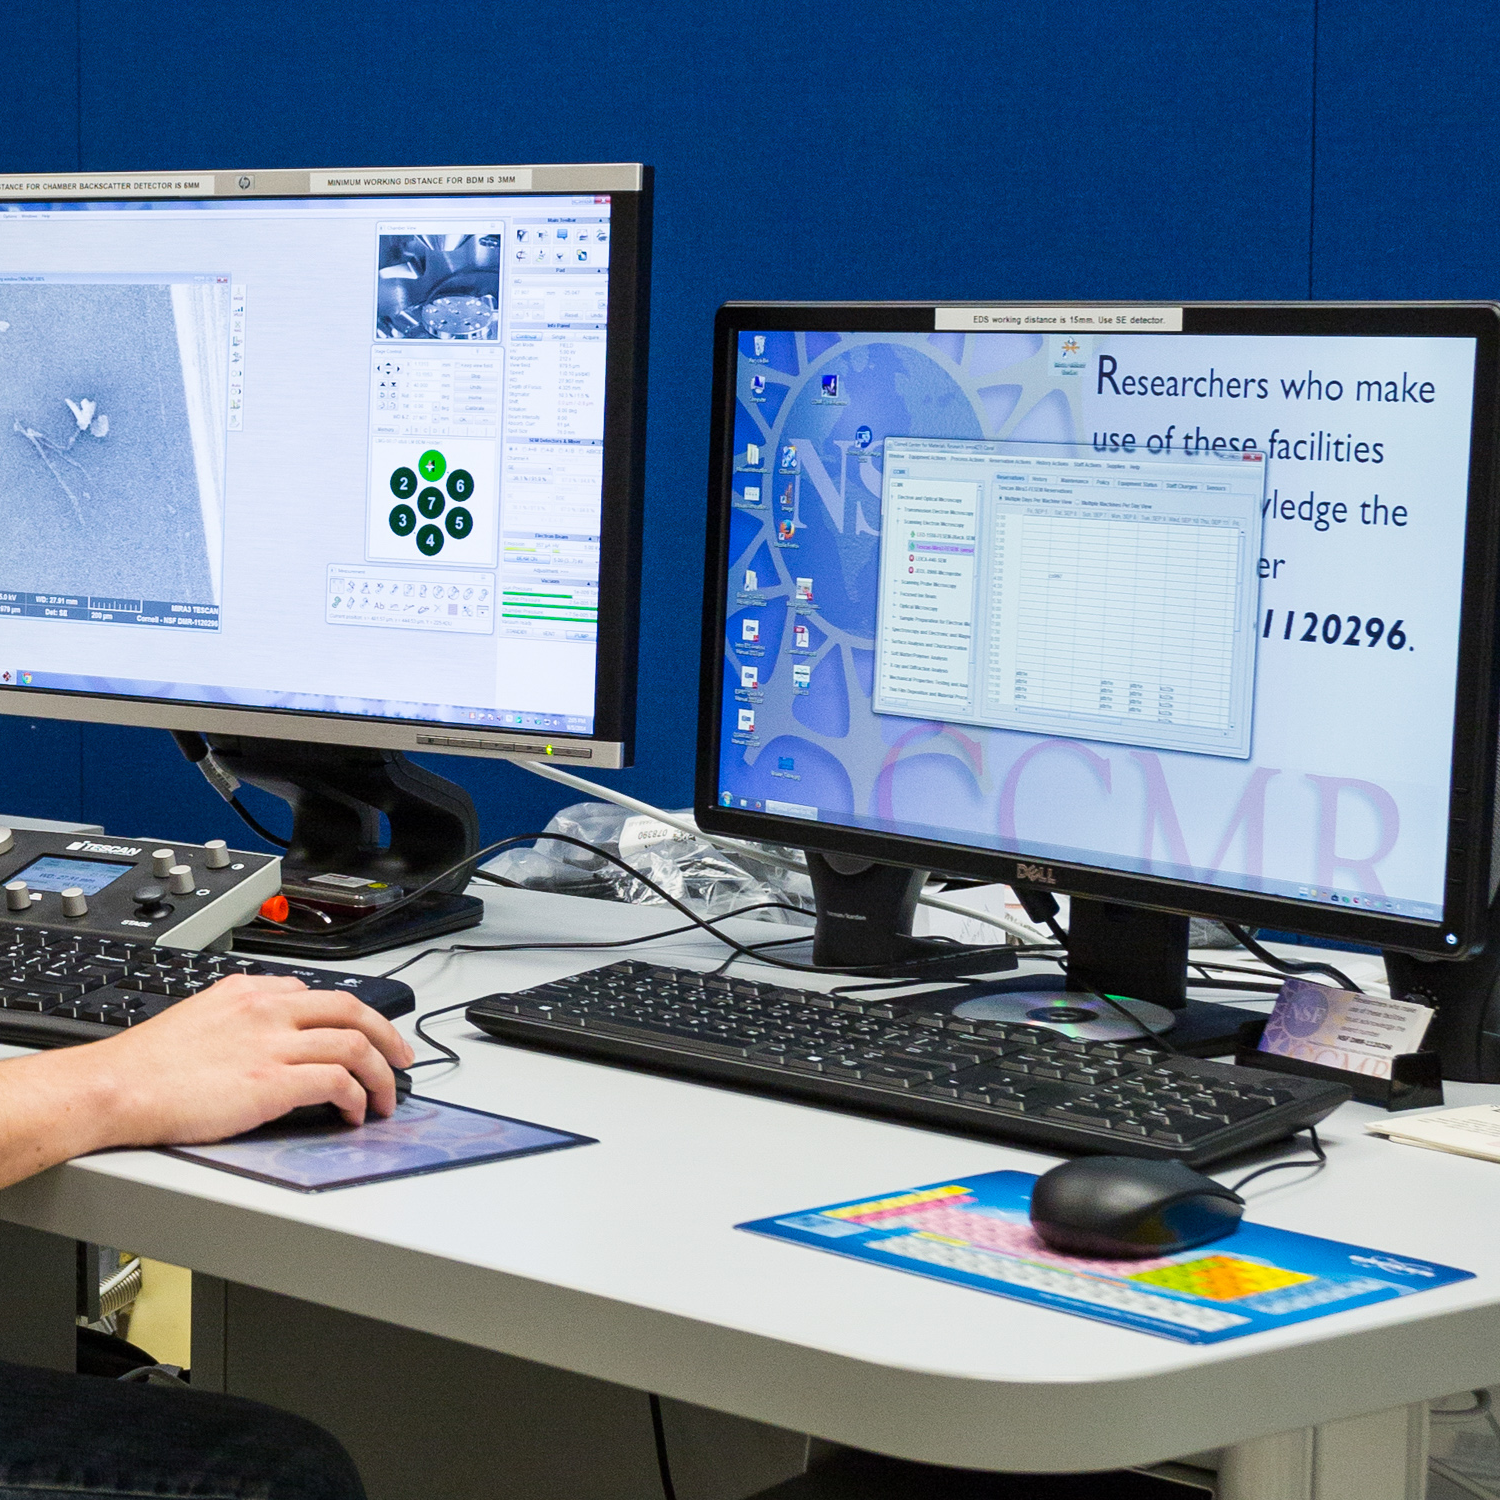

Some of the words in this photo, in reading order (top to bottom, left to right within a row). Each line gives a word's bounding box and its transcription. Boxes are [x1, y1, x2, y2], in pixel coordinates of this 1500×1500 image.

[79, 182, 131, 190] BACKSCATTER
[134, 182, 172, 190] DETECTOR
[327, 178, 361, 186] MINIMUM
[364, 178, 401, 186] WORKING
[404, 177, 443, 185] DISTANCE
[466, 176, 484, 184] BDM
[487, 176, 494, 184] IS
[498, 176, 516, 184] 3MM
[992, 316, 1021, 325] working
[1025, 316, 1057, 324] distance
[1060, 316, 1066, 324] is
[1070, 316, 1095, 324] 15mm.
[1098, 316, 1112, 324] Use
[1115, 316, 1126, 324] SE
[1130, 316, 1165, 324] detector.
[1096, 354, 1269, 400] Researchers
[1280, 370, 1343, 402] who
[1355, 371, 1436, 405] make
[1093, 431, 1136, 454] use
[1146, 425, 1176, 455] of
[1183, 426, 1258, 457] these
[1268, 428, 1385, 464] facilities
[399, 477, 408, 490] 2
[456, 479, 464, 492] 6
[427, 497, 436, 510] 7
[1360, 494, 1409, 527] the
[399, 514, 407, 527] 3
[455, 516, 463, 529] 5
[426, 534, 435, 547] 4
[0, 593, 8, 601] 5.0
[9, 593, 17, 602] kV
[36, 595, 48, 604] WD:
[49, 596, 65, 605] 27.91
[66, 598, 78, 606] mm
[91, 611, 101, 619] 200
[171, 604, 191, 613] MIRA3
[192, 605, 218, 615] TESCAN
[136, 614, 158, 624] Cornell
[163, 616, 177, 625] NSF
[1262, 608, 1416, 652] 1120296.
[638, 828, 668, 840] 078390
[83, 841, 142, 856] TESCAN
[1016, 863, 1056, 885] DELL
[120, 919, 152, 928] STAGE
